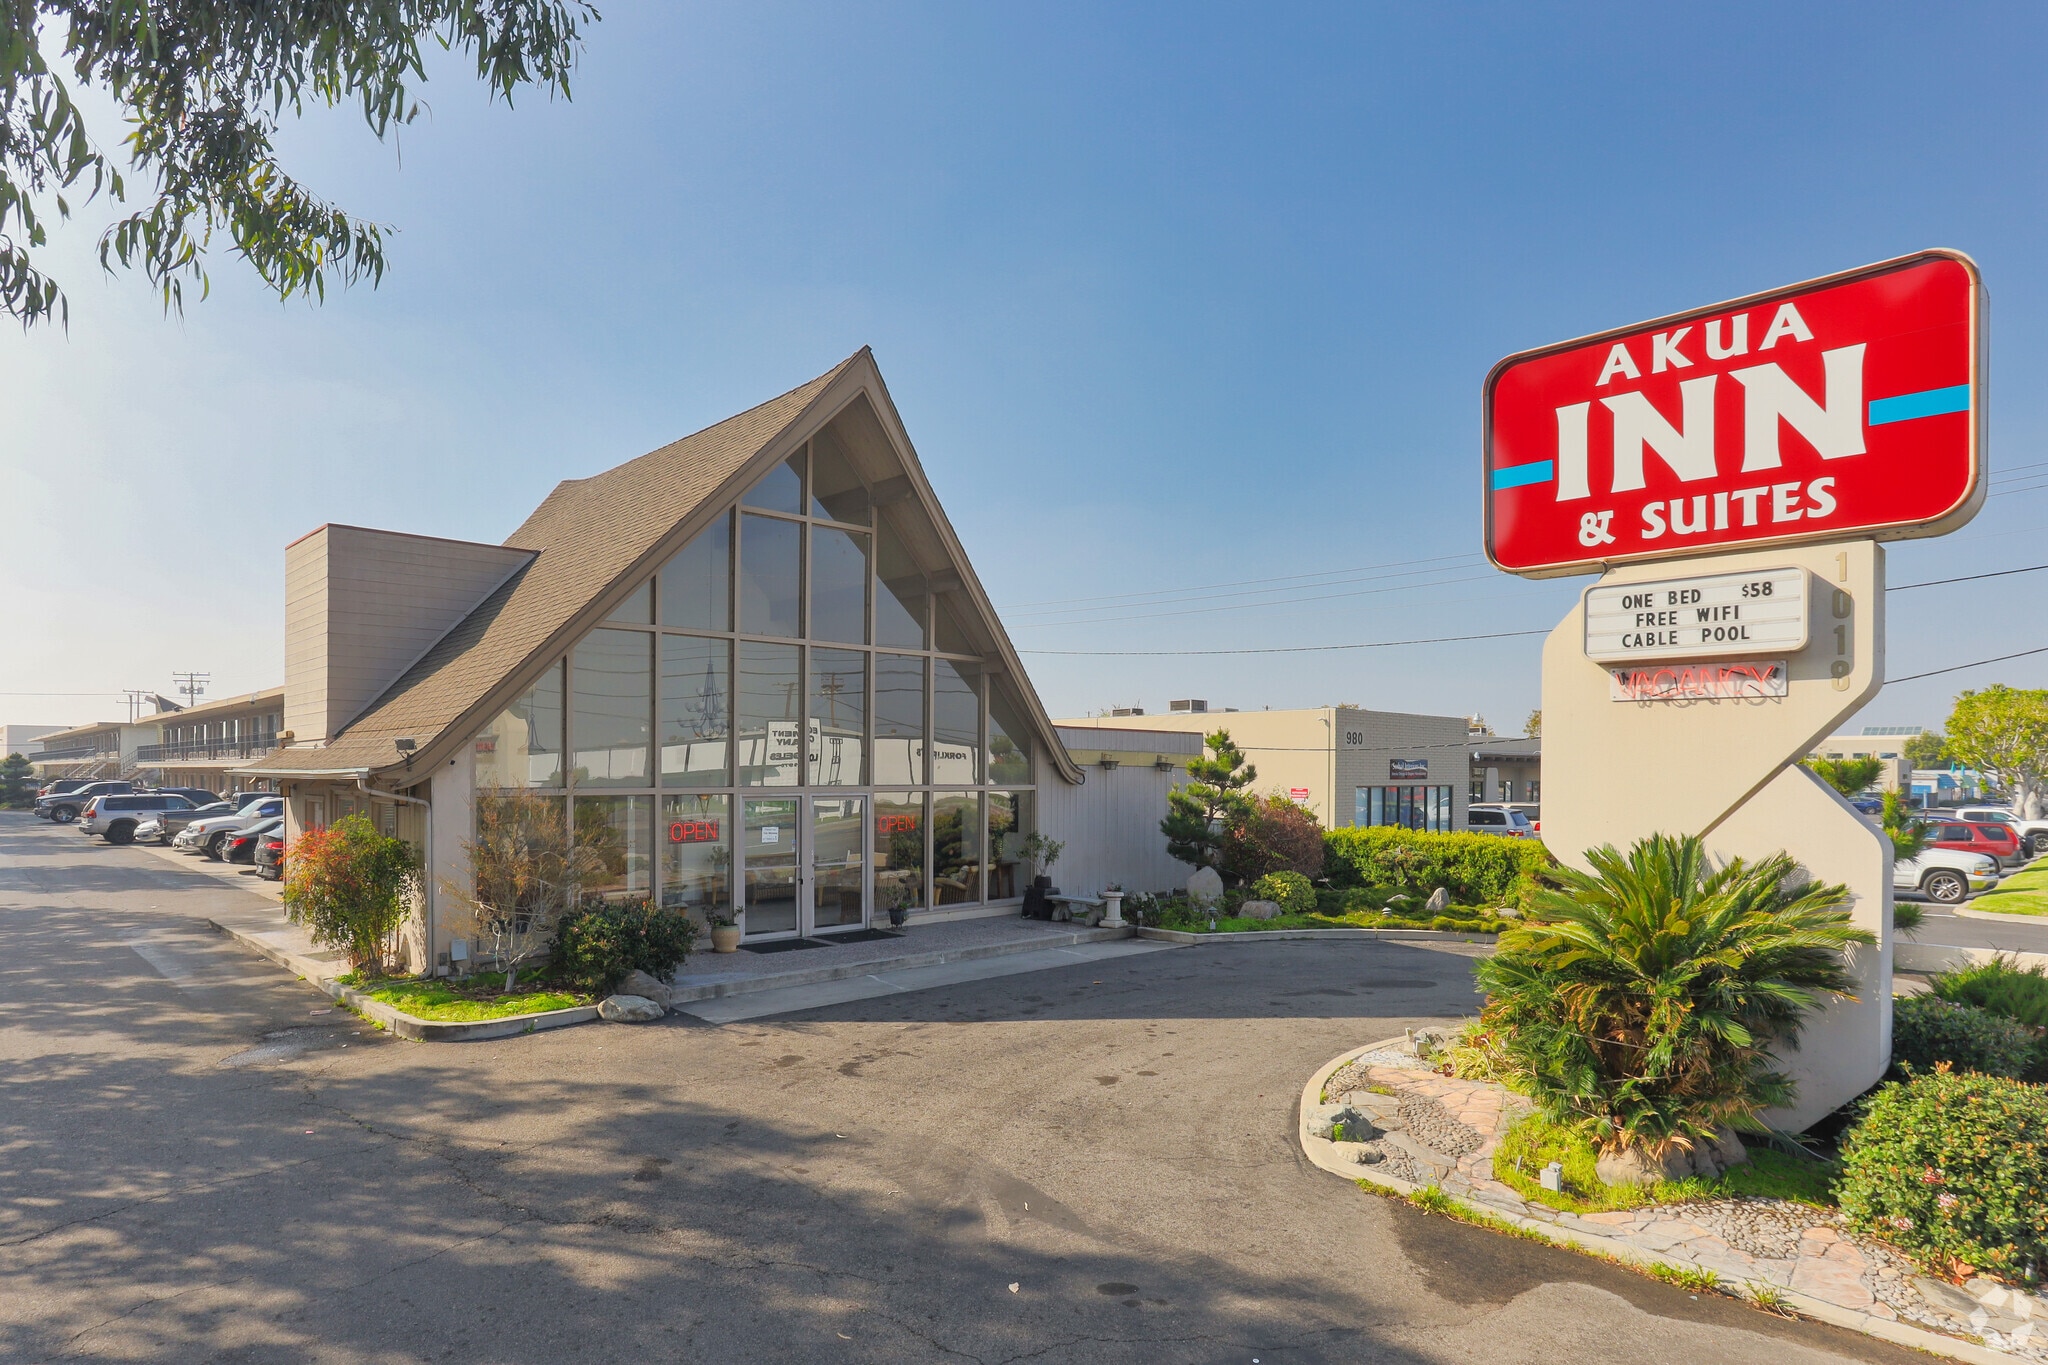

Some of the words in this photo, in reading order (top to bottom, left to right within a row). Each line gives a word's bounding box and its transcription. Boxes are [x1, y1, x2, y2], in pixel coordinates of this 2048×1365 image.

[1595, 303, 1815, 387] AKUA
[1555, 343, 1868, 502] INN
[1578, 510, 1616, 547] &
[1641, 477, 1838, 540] SUITES
[1622, 593, 1653, 609] ONE
[1668, 589, 1702, 605] BED
[1741, 581, 1773, 598] $58
[1636, 611, 1678, 627] FREE
[1696, 605, 1740, 622] WIFI
[1622, 630, 1678, 648] CABLE
[1701, 625, 1750, 642] POOL
[1615, 664, 1774, 699] VACANCY
[1346, 731, 1363, 745] 980
[671, 821, 718, 842] OPEN
[878, 815, 916, 833] OPEN
